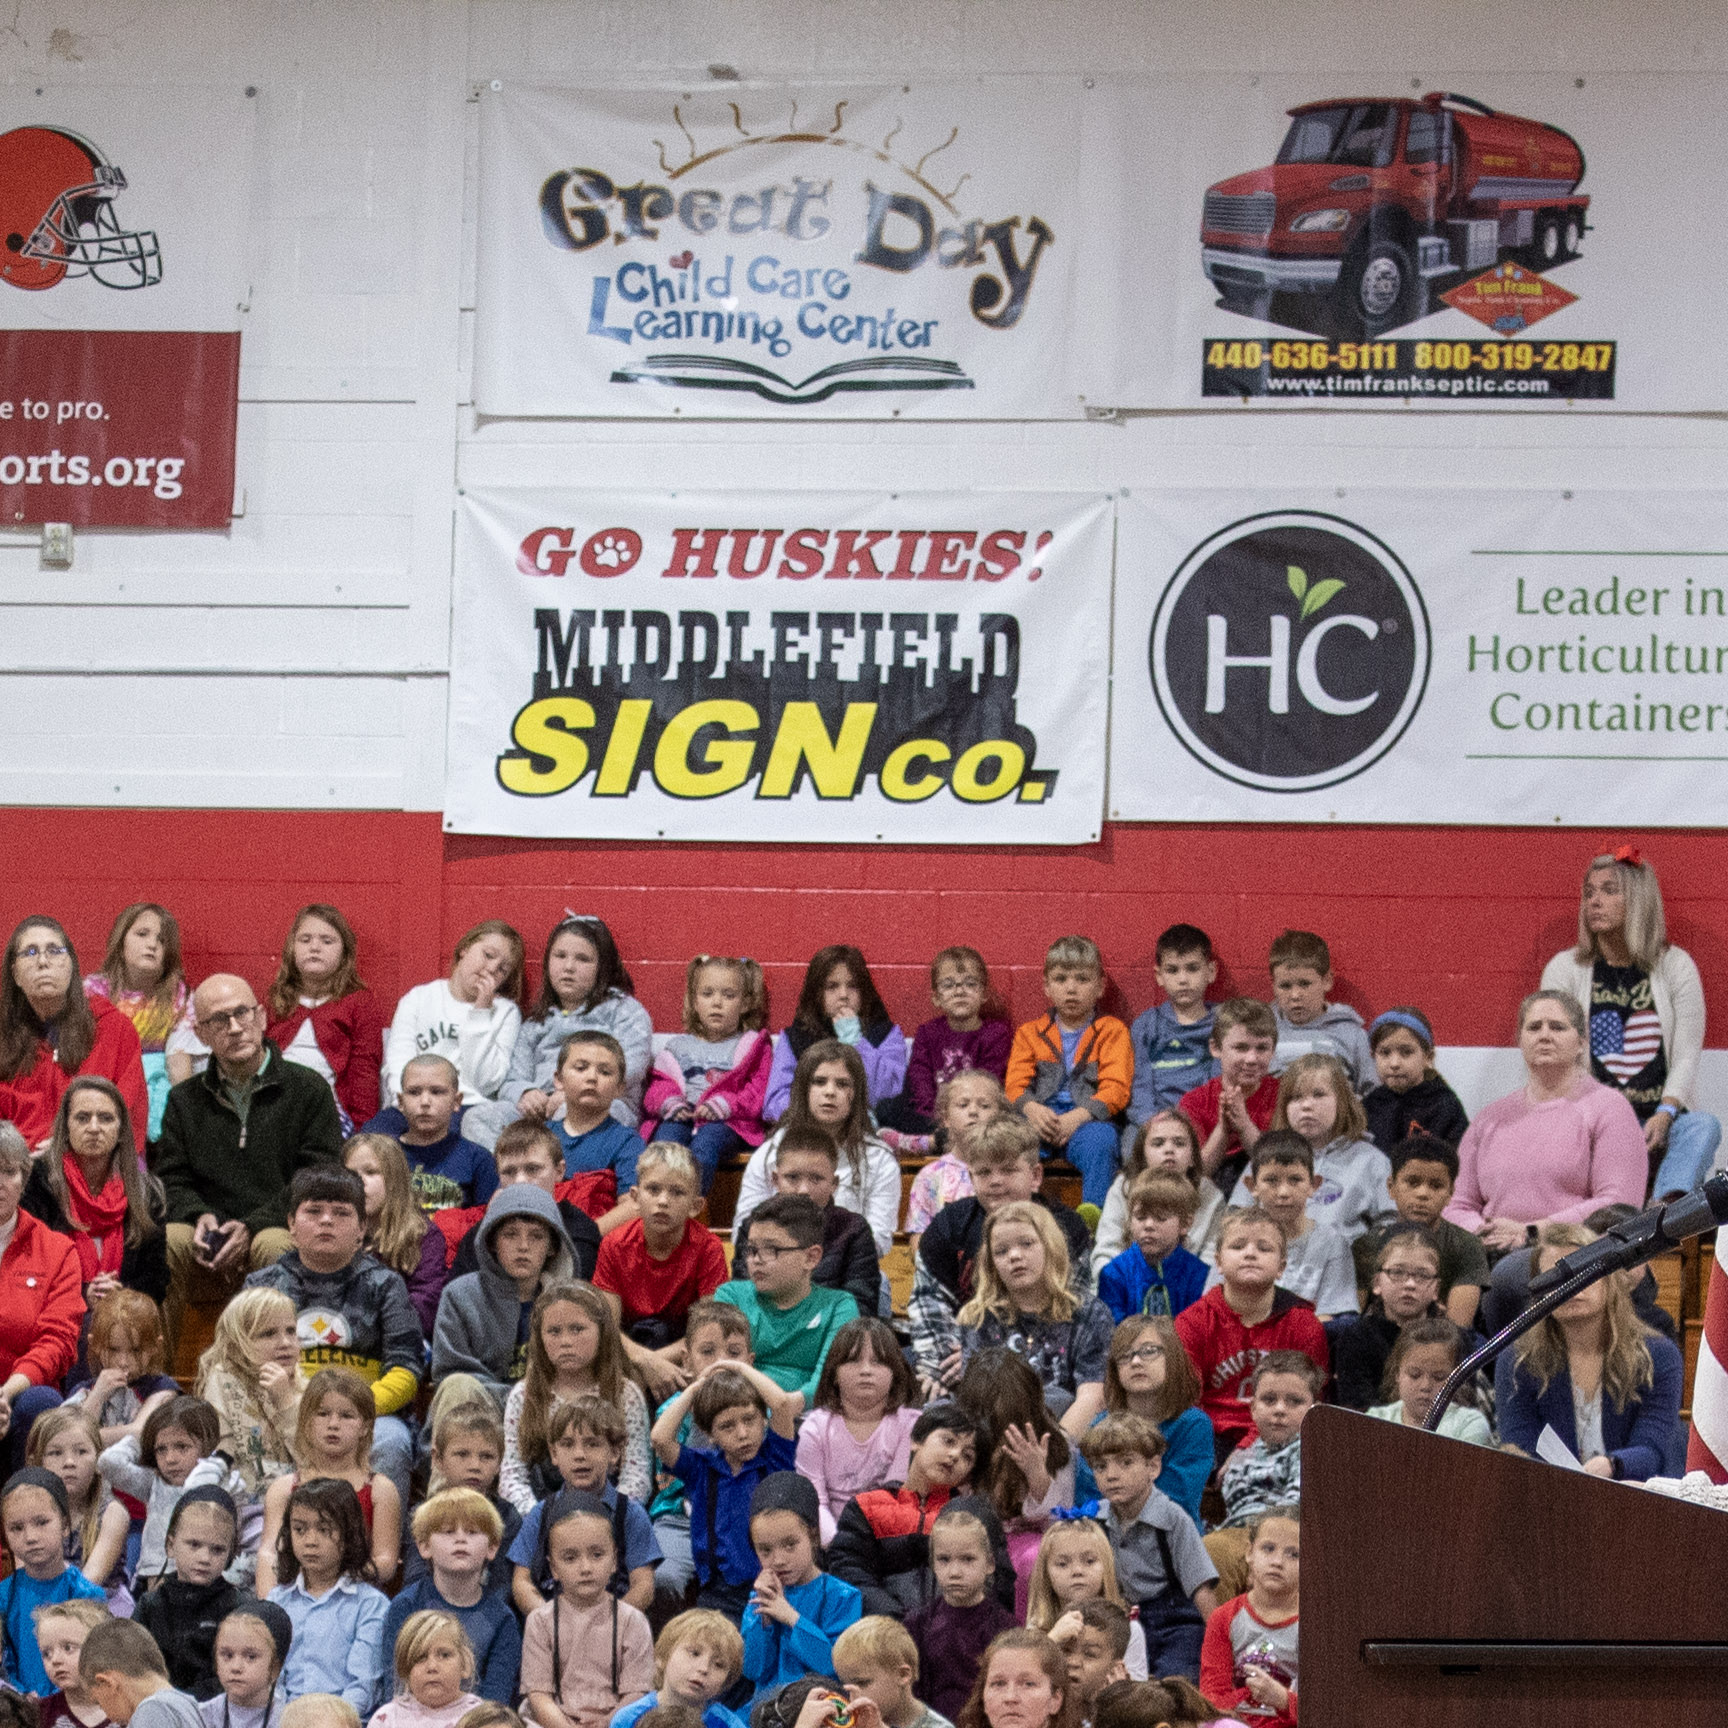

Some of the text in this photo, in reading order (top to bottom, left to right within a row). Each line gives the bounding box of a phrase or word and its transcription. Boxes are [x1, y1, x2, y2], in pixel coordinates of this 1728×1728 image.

[538, 166, 1055, 331] Great Day
[616, 254, 851, 303] Child Care
[586, 276, 940, 359] Learning Center
[1206, 341, 1613, 374] 440-636-5111 800-319-2847
[1267, 375, 1550, 396] www.timfrankseptic.com
[22, 398, 50, 421] to
[56, 401, 110, 427] pro.
[660, 527, 1054, 584] HUSKIES!
[1515, 576, 1726, 618] Leader in
[533, 607, 1022, 692] MIDDLEFIELD
[1204, 612, 1381, 717] HC
[496, 696, 880, 800] SIGN
